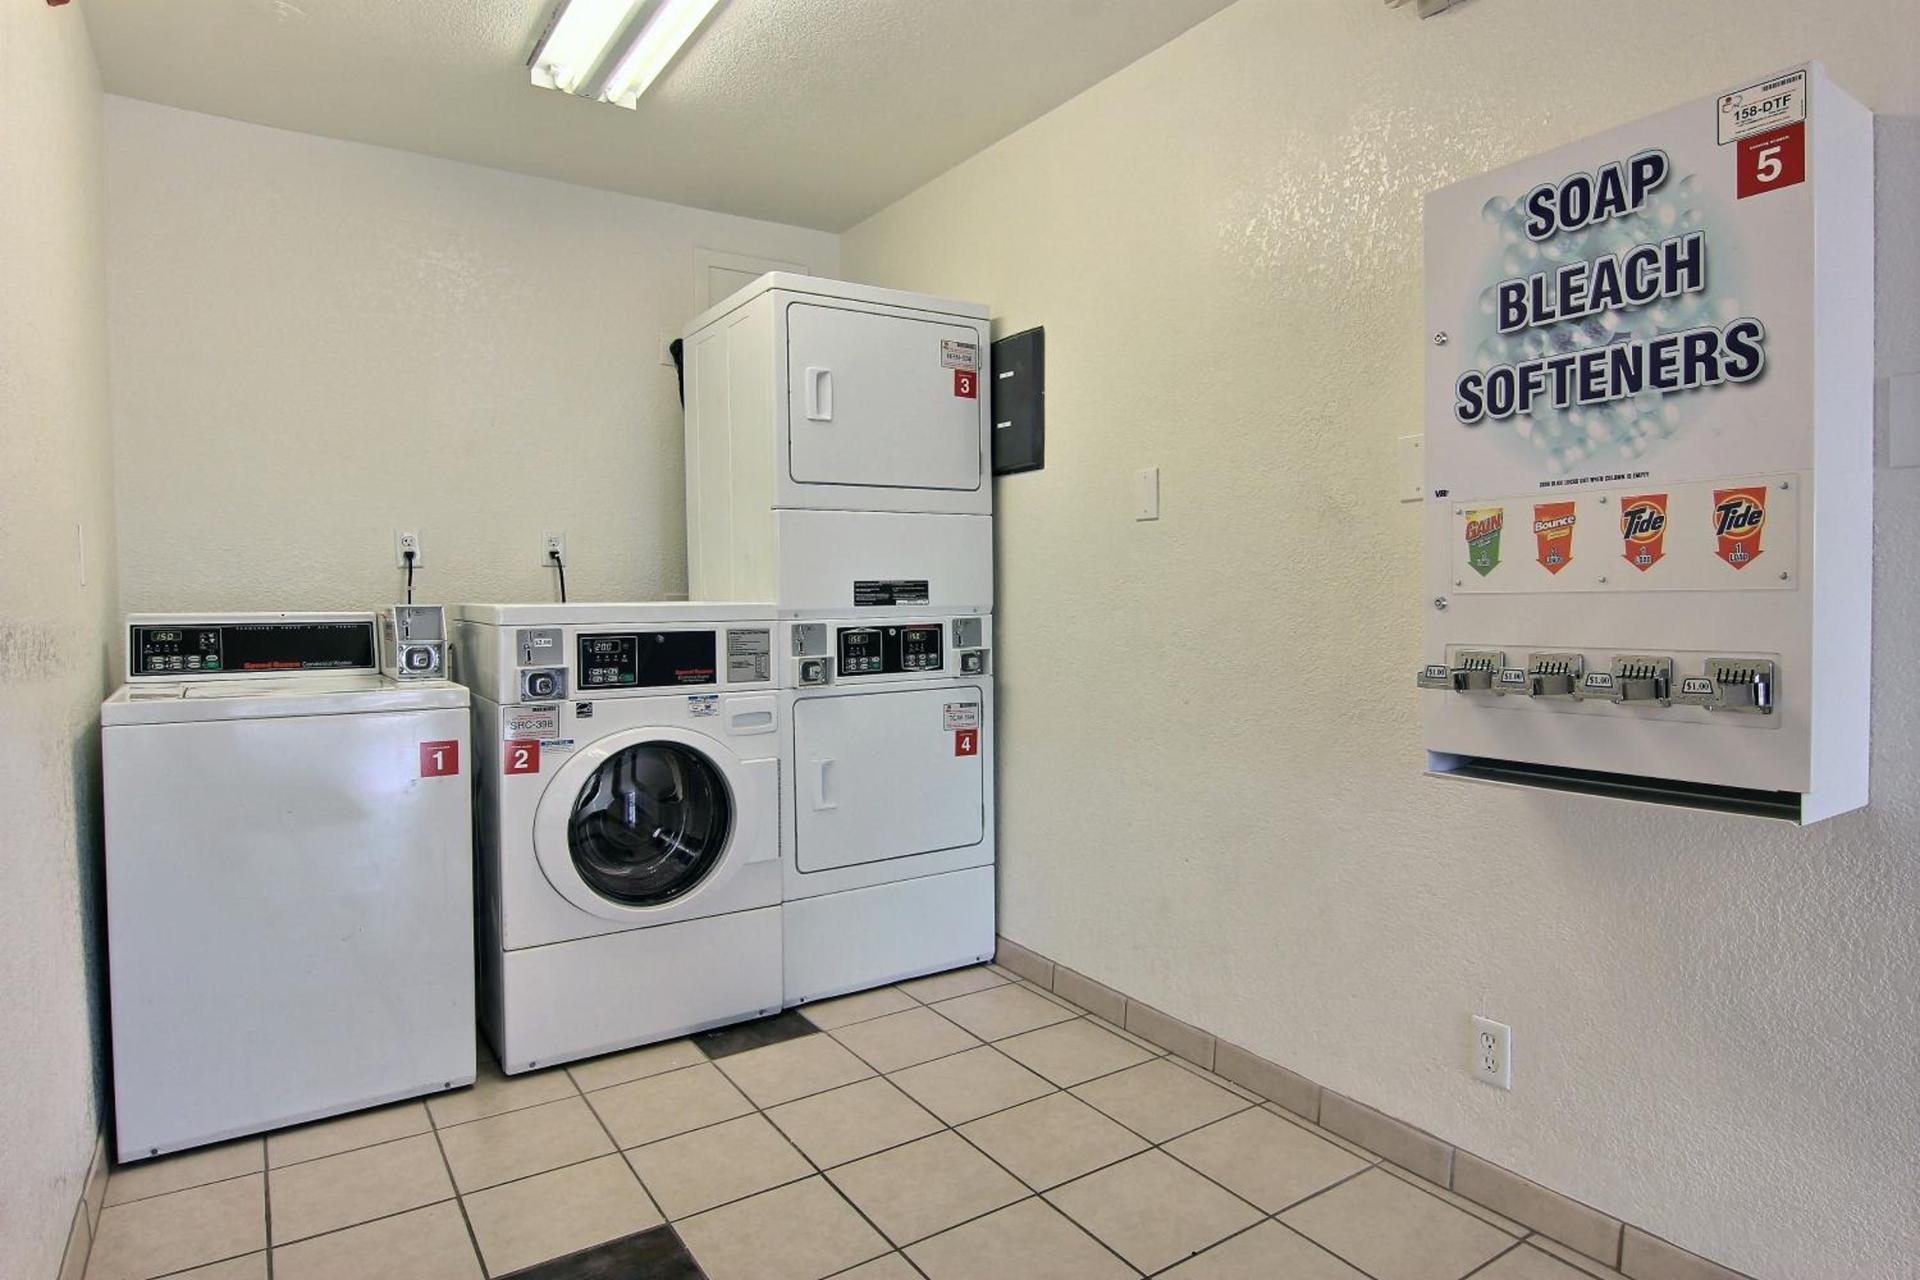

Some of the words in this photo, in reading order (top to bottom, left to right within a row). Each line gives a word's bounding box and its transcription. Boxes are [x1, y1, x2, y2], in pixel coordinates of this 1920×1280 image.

[1734, 94, 1792, 121] 158-DTF
[1756, 145, 1783, 183] 5
[1524, 149, 1669, 243] SOAP
[1497, 230, 1705, 334] BLEACH
[1454, 316, 1766, 424] SOFTENERS
[960, 378, 970, 394] 3
[1534, 513, 1575, 533] Bounce
[1623, 507, 1665, 539] Tide
[1715, 500, 1763, 536] Tide
[1589, 675, 1610, 685] $1.00
[1686, 679, 1710, 691] $1.00
[961, 736, 971, 752] 4
[432, 751, 443, 770] 1
[514, 749, 529, 769] 2
